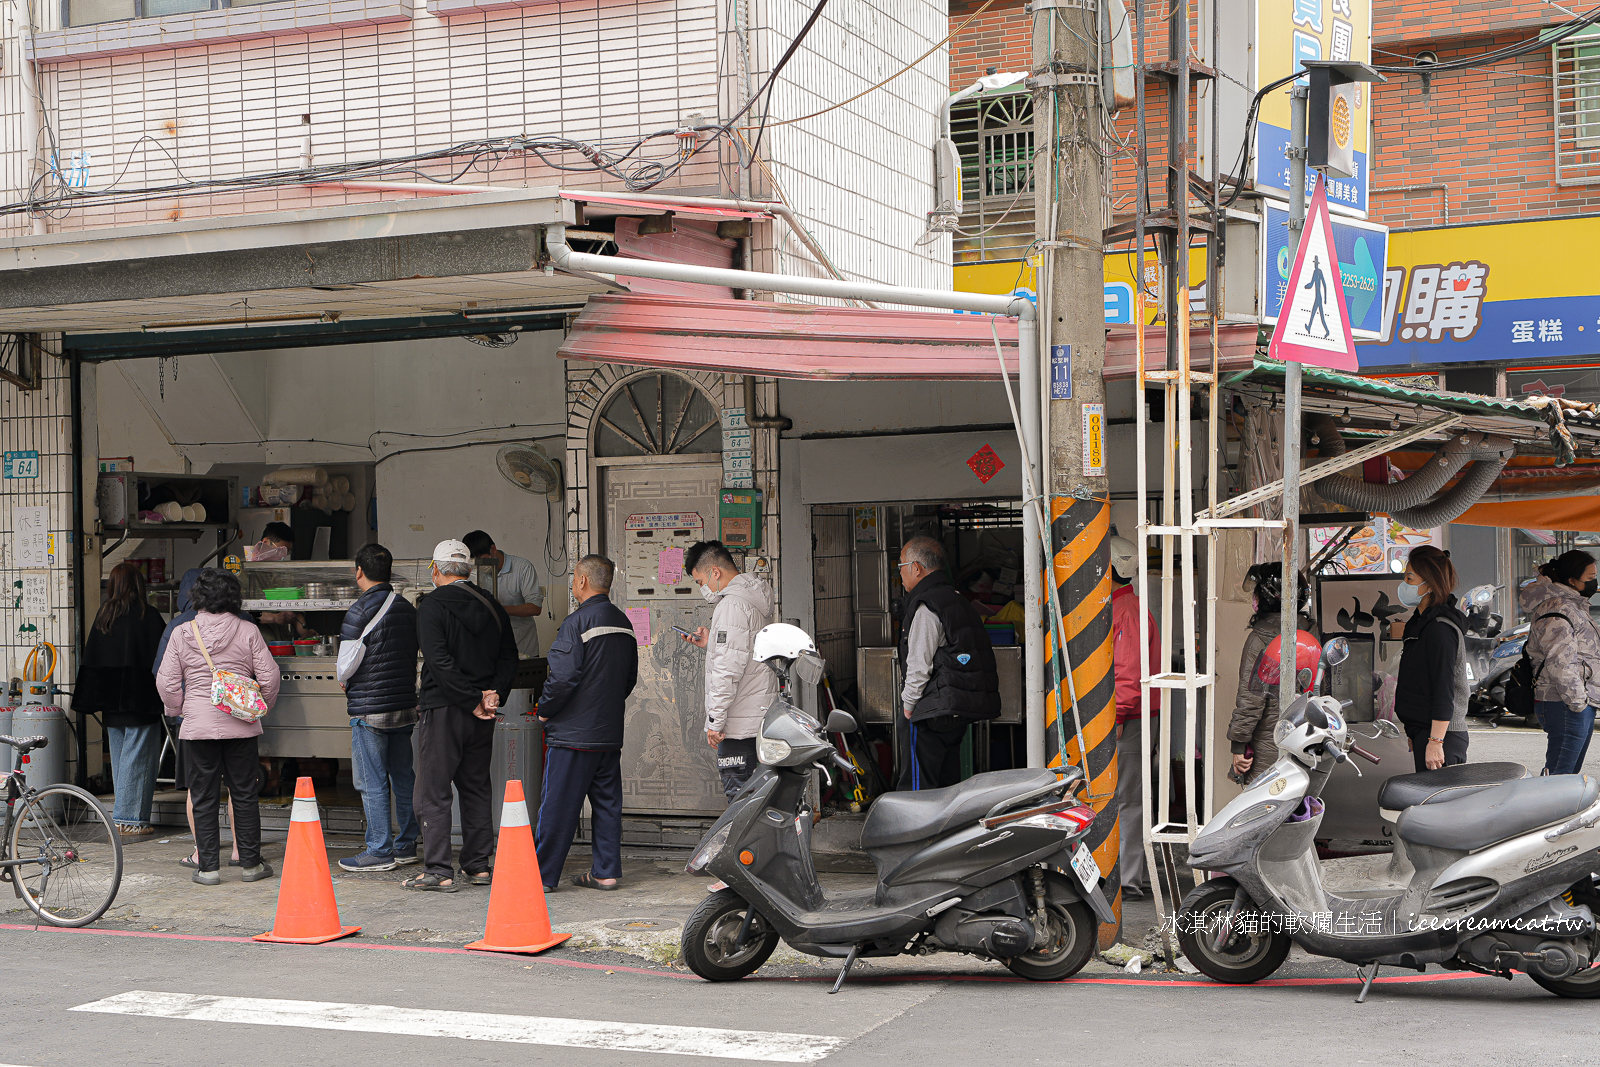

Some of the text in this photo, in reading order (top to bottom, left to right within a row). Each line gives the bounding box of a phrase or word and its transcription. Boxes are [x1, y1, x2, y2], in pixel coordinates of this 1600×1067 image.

[1342, 272, 1375, 292] 2253-2623
[1511, 318, 1563, 343] 蛋糕
[1054, 365, 1067, 380] 11
[730, 418, 740, 426] 64
[731, 439, 741, 447] 64
[1092, 416, 1100, 465] 001189
[18, 461, 32, 475] 64
[732, 460, 742, 468] 64
